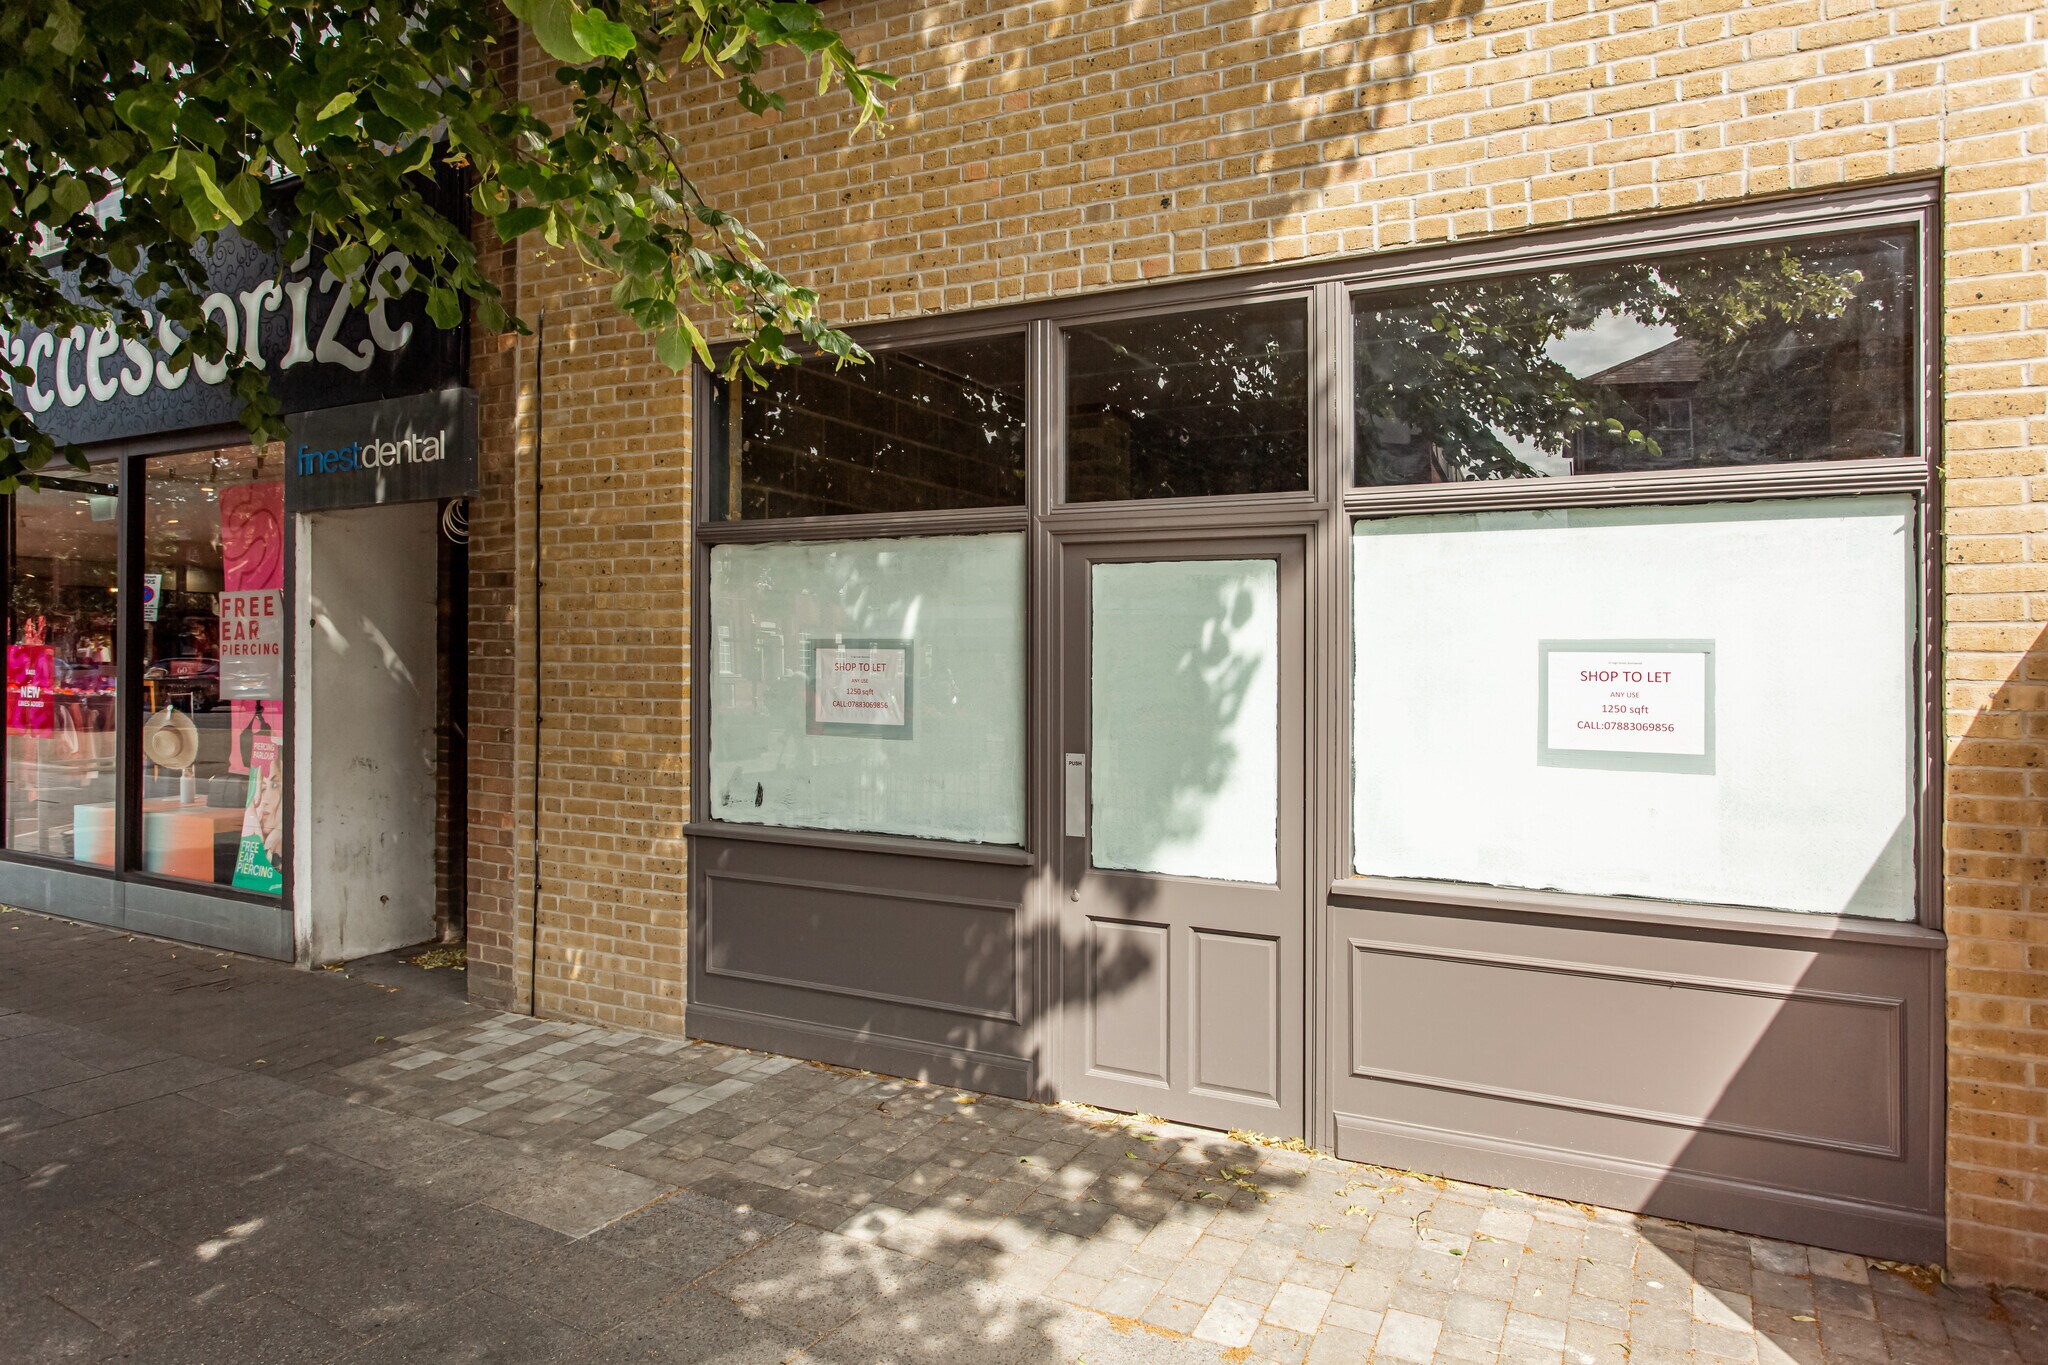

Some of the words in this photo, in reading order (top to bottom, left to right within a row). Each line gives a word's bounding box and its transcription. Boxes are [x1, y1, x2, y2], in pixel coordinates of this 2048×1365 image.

[221, 595, 274, 618] FREE
[221, 620, 260, 641] EAR
[221, 642, 279, 656] PIERCING
[834, 662, 857, 671] SHOP
[858, 662, 870, 672] TO
[872, 663, 886, 672] LET
[1580, 670, 1619, 682] SHOP
[1622, 671, 1643, 683] TO
[1647, 671, 1672, 683] LET
[20, 685, 41, 698] NEW
[862, 688, 874, 696] sqft
[832, 700, 888, 709] CALL:07883069856
[1601, 704, 1627, 714] 1250
[1629, 704, 1649, 716] sqft
[1576, 720, 1675, 733] CALL:07883069856
[253, 742, 275, 752] PIERCING
[253, 751, 275, 761] PARLOUR
[240, 840, 260, 854] FREE
[238, 851, 255, 864] EAR
[236, 862, 274, 879] PIERCING
